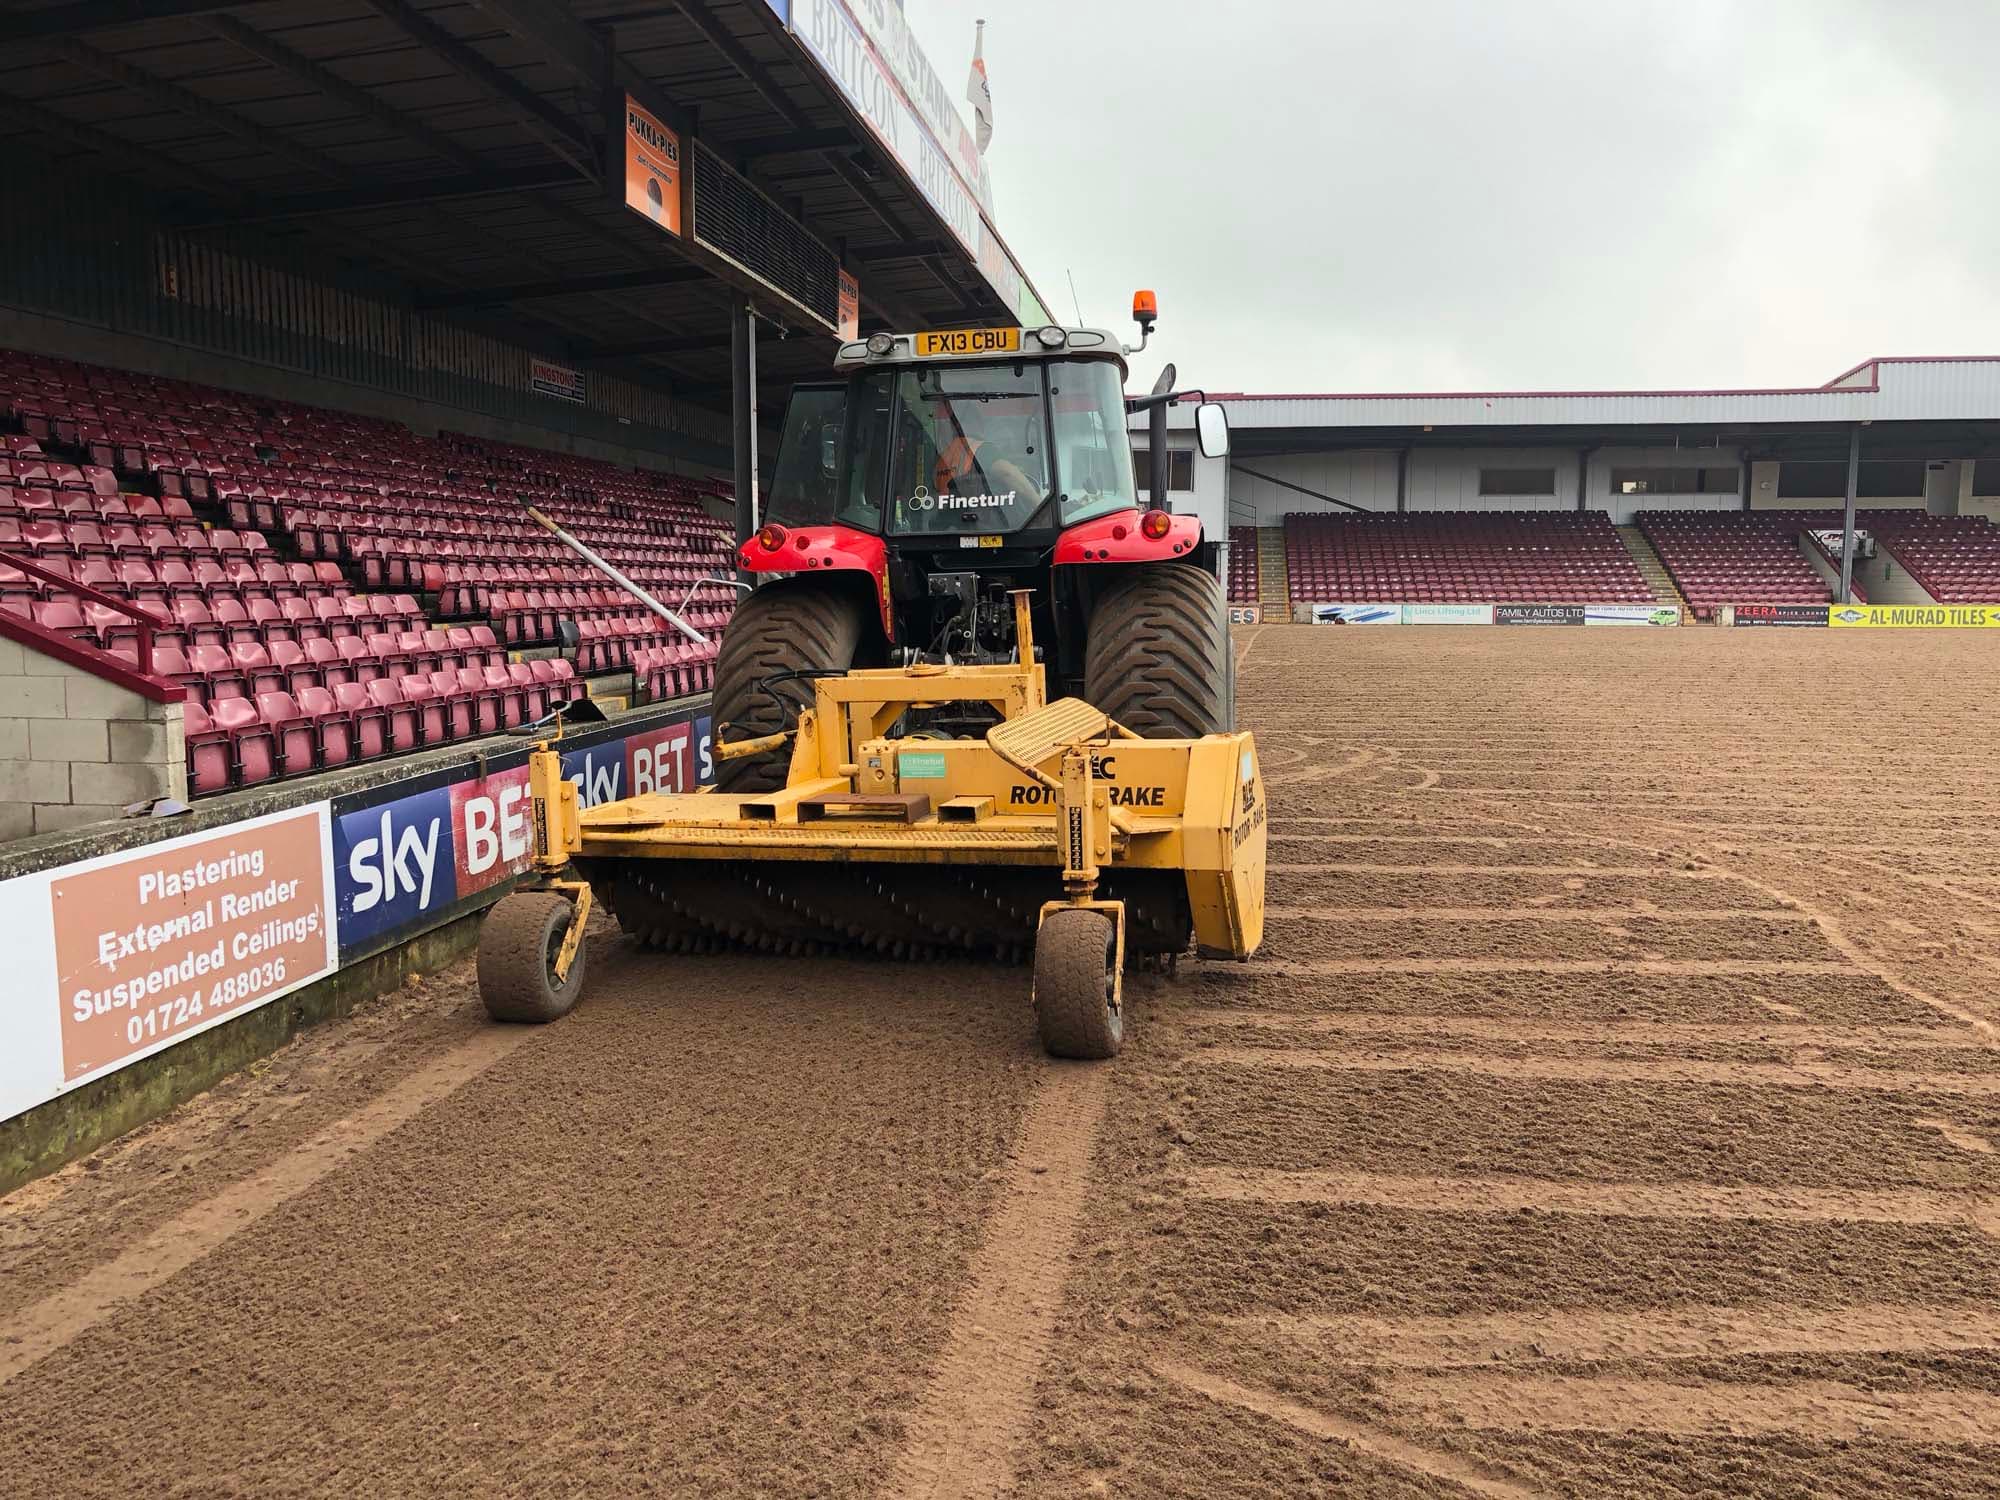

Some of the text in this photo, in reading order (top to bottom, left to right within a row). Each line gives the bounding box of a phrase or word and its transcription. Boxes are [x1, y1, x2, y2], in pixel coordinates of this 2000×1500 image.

[928, 331, 1007, 352] FX13 CBU
[938, 491, 1016, 510] Fineturf
[1496, 608, 1531, 617] FAMILY
[1532, 608, 1564, 617] AUTOS
[1566, 608, 1584, 617] LTD
[1736, 607, 1777, 615] ZEERA
[1869, 609, 1986, 625] AL-MURAD TILES
[633, 735, 688, 797] BET
[464, 783, 531, 875] BE
[139, 849, 265, 904] Plastering
[350, 810, 440, 913] sky
[99, 878, 299, 965] External Render
[72, 911, 318, 1023] Suspended Ceilings
[127, 957, 287, 1044] 01724 488036
